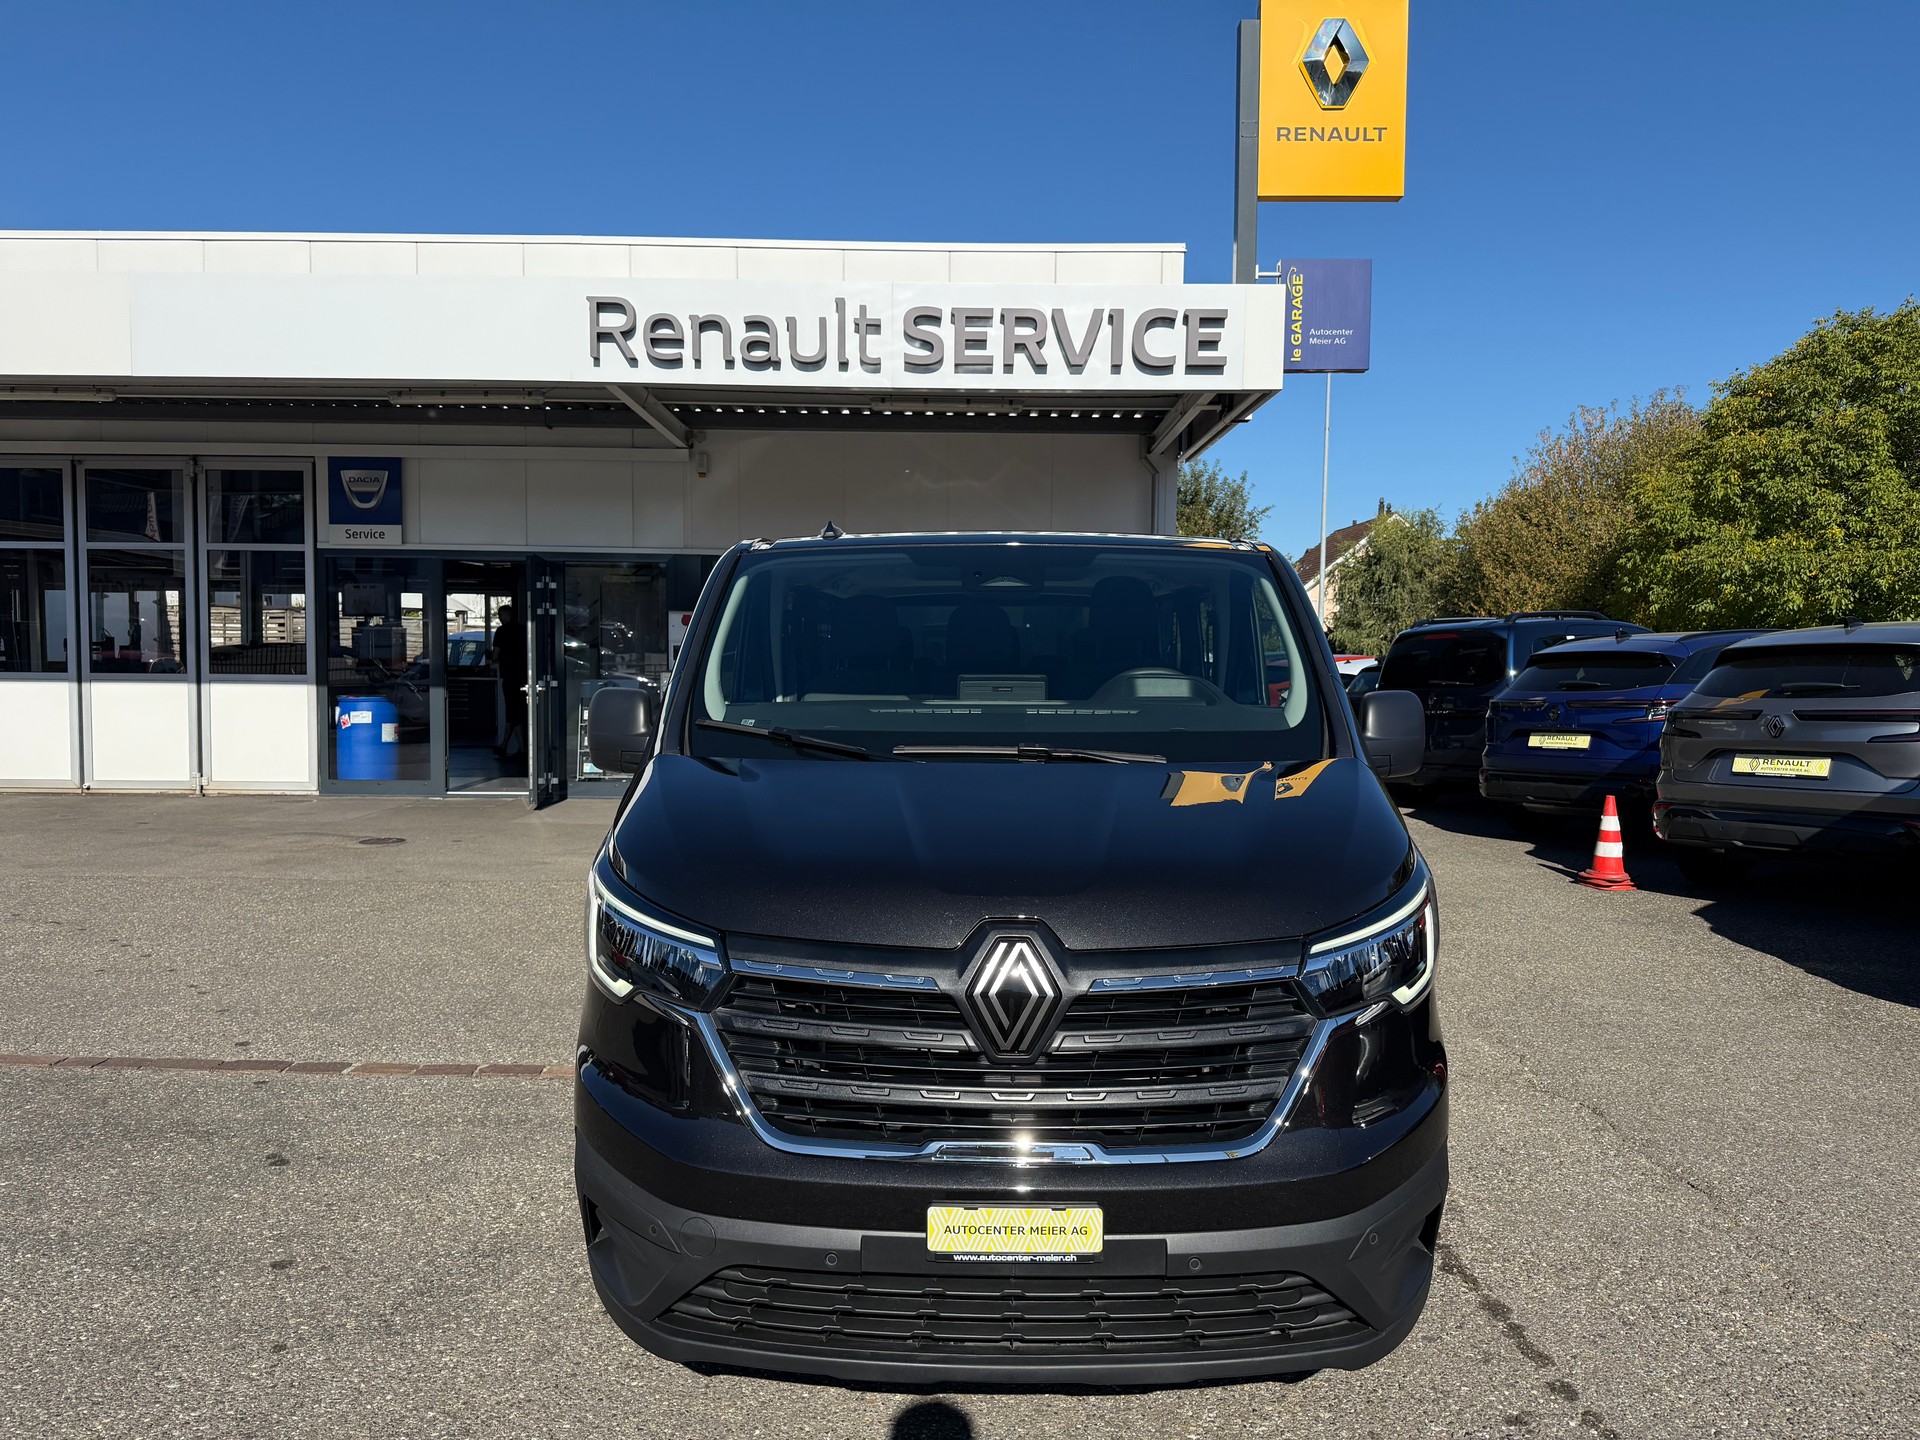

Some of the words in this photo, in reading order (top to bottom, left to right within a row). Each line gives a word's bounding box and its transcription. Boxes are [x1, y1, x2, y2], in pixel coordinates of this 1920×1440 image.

[1276, 126, 1388, 142] RENAULT
[1291, 273, 1304, 346] GARAGE
[585, 296, 882, 371] Renault
[902, 305, 1229, 376] SERVICE
[1309, 328, 1353, 336] Autocenter
[1309, 337, 1332, 345] Meier
[1291, 348, 1302, 362] le
[345, 528, 386, 539] Service
[1762, 758, 1812, 767] RENAULT
[943, 1225, 1025, 1236] AUTOCENTER
[1029, 1226, 1067, 1236] MEIER
[1071, 1226, 1088, 1236] AG
[953, 1253, 1077, 1262] www.autocenter-meier.ch
